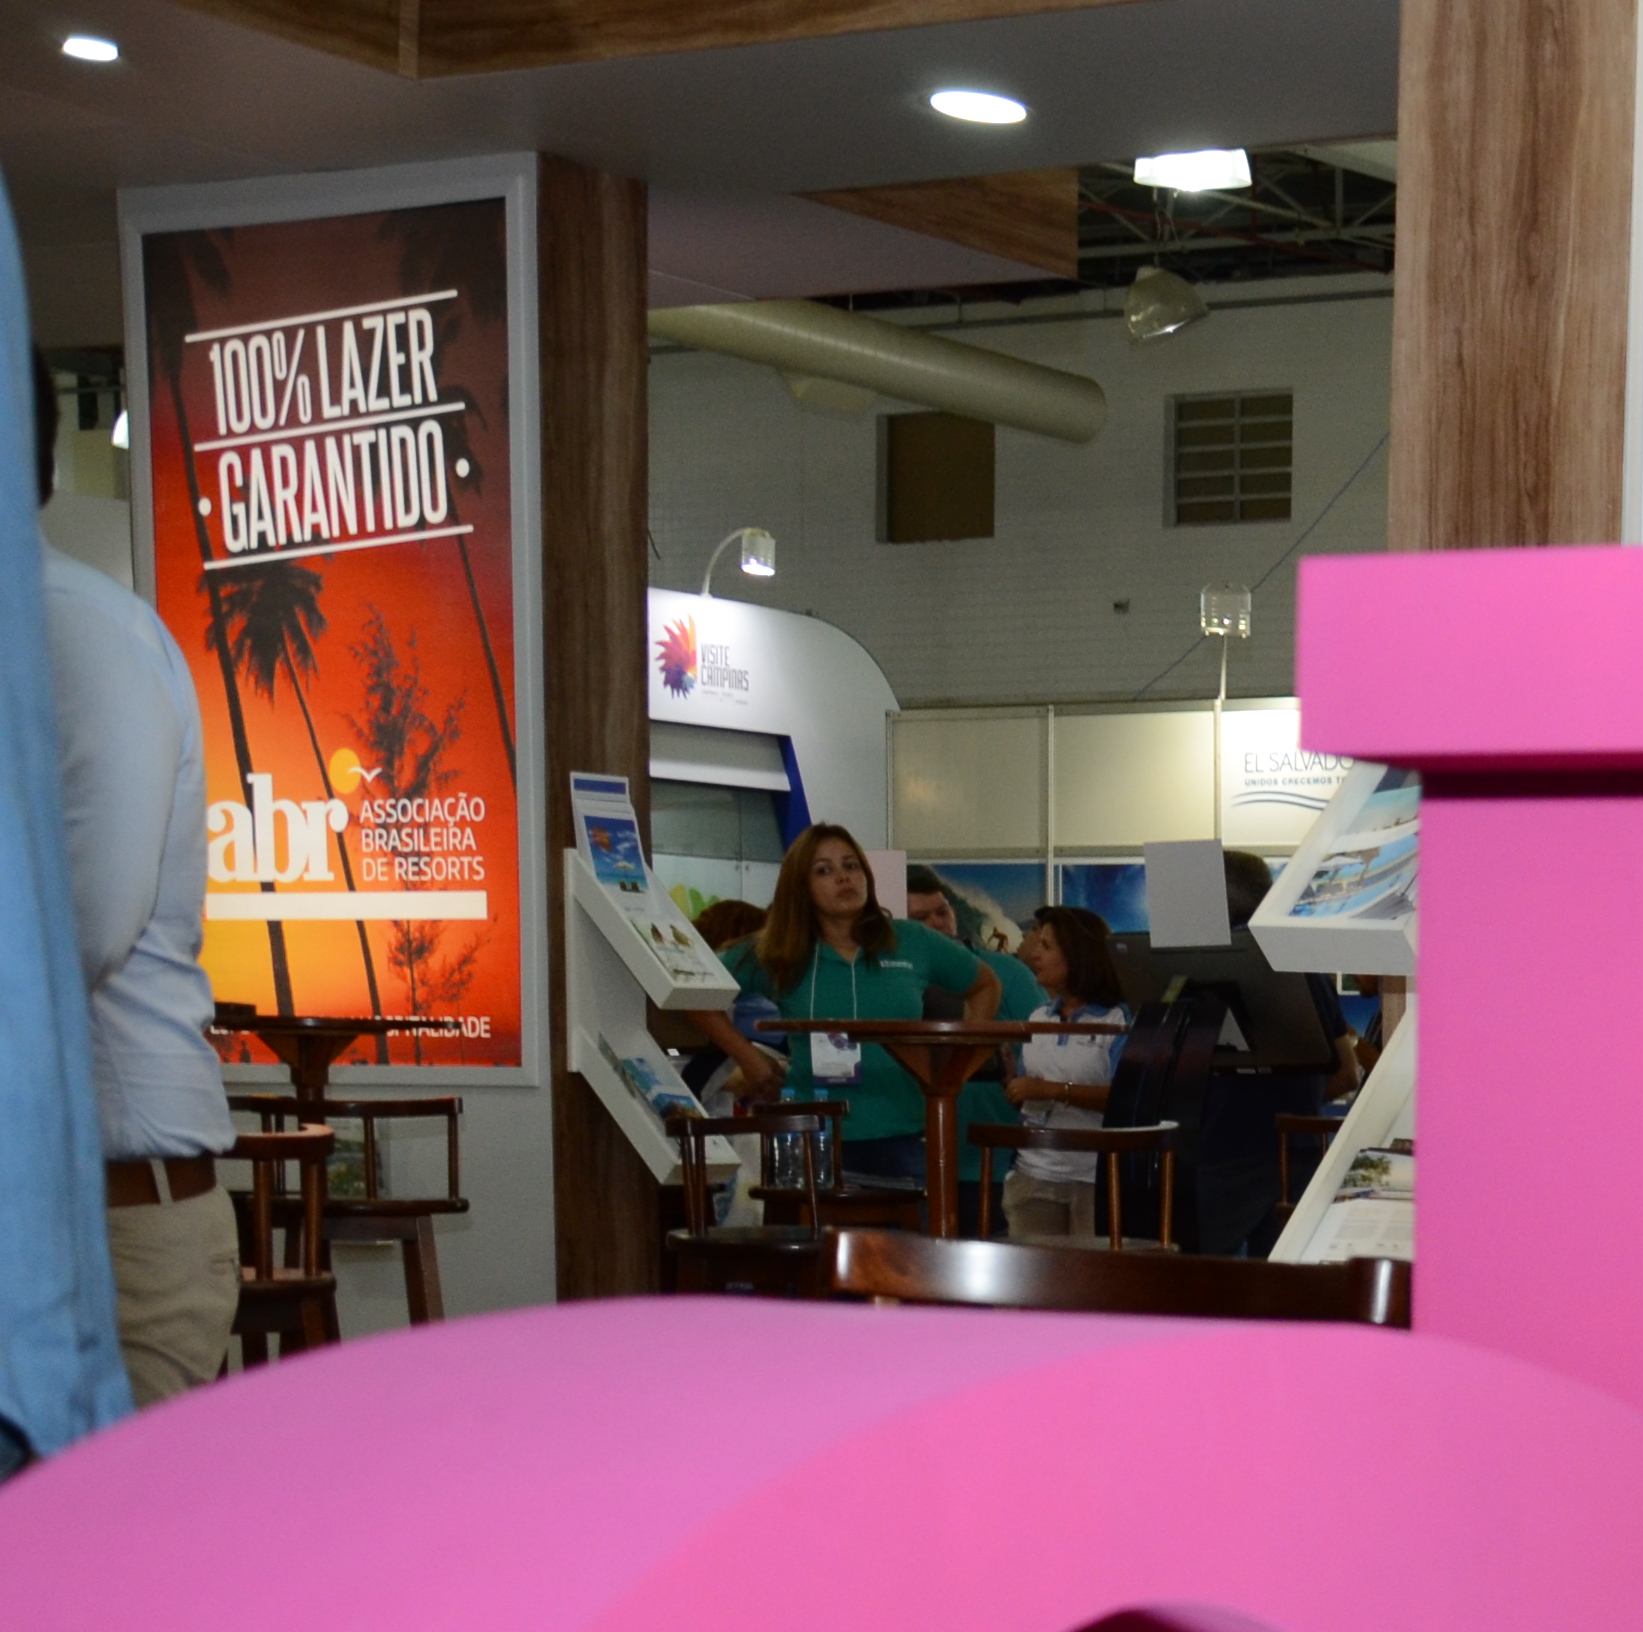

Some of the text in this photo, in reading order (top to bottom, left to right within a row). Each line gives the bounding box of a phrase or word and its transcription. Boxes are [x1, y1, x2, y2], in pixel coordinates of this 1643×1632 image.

[209, 308, 438, 436] 100% LAZER
[218, 419, 448, 553] GARANTIDO
[700, 643, 730, 667] VISITE
[1244, 750, 1356, 773] EL SALVADO
[1245, 778, 1278, 786] UNIDOS
[359, 792, 486, 827] ASSOCIAÇÃO
[208, 773, 349, 883] abr
[361, 826, 477, 852] BRASILEIRA
[363, 856, 486, 881] DE RESORTS
